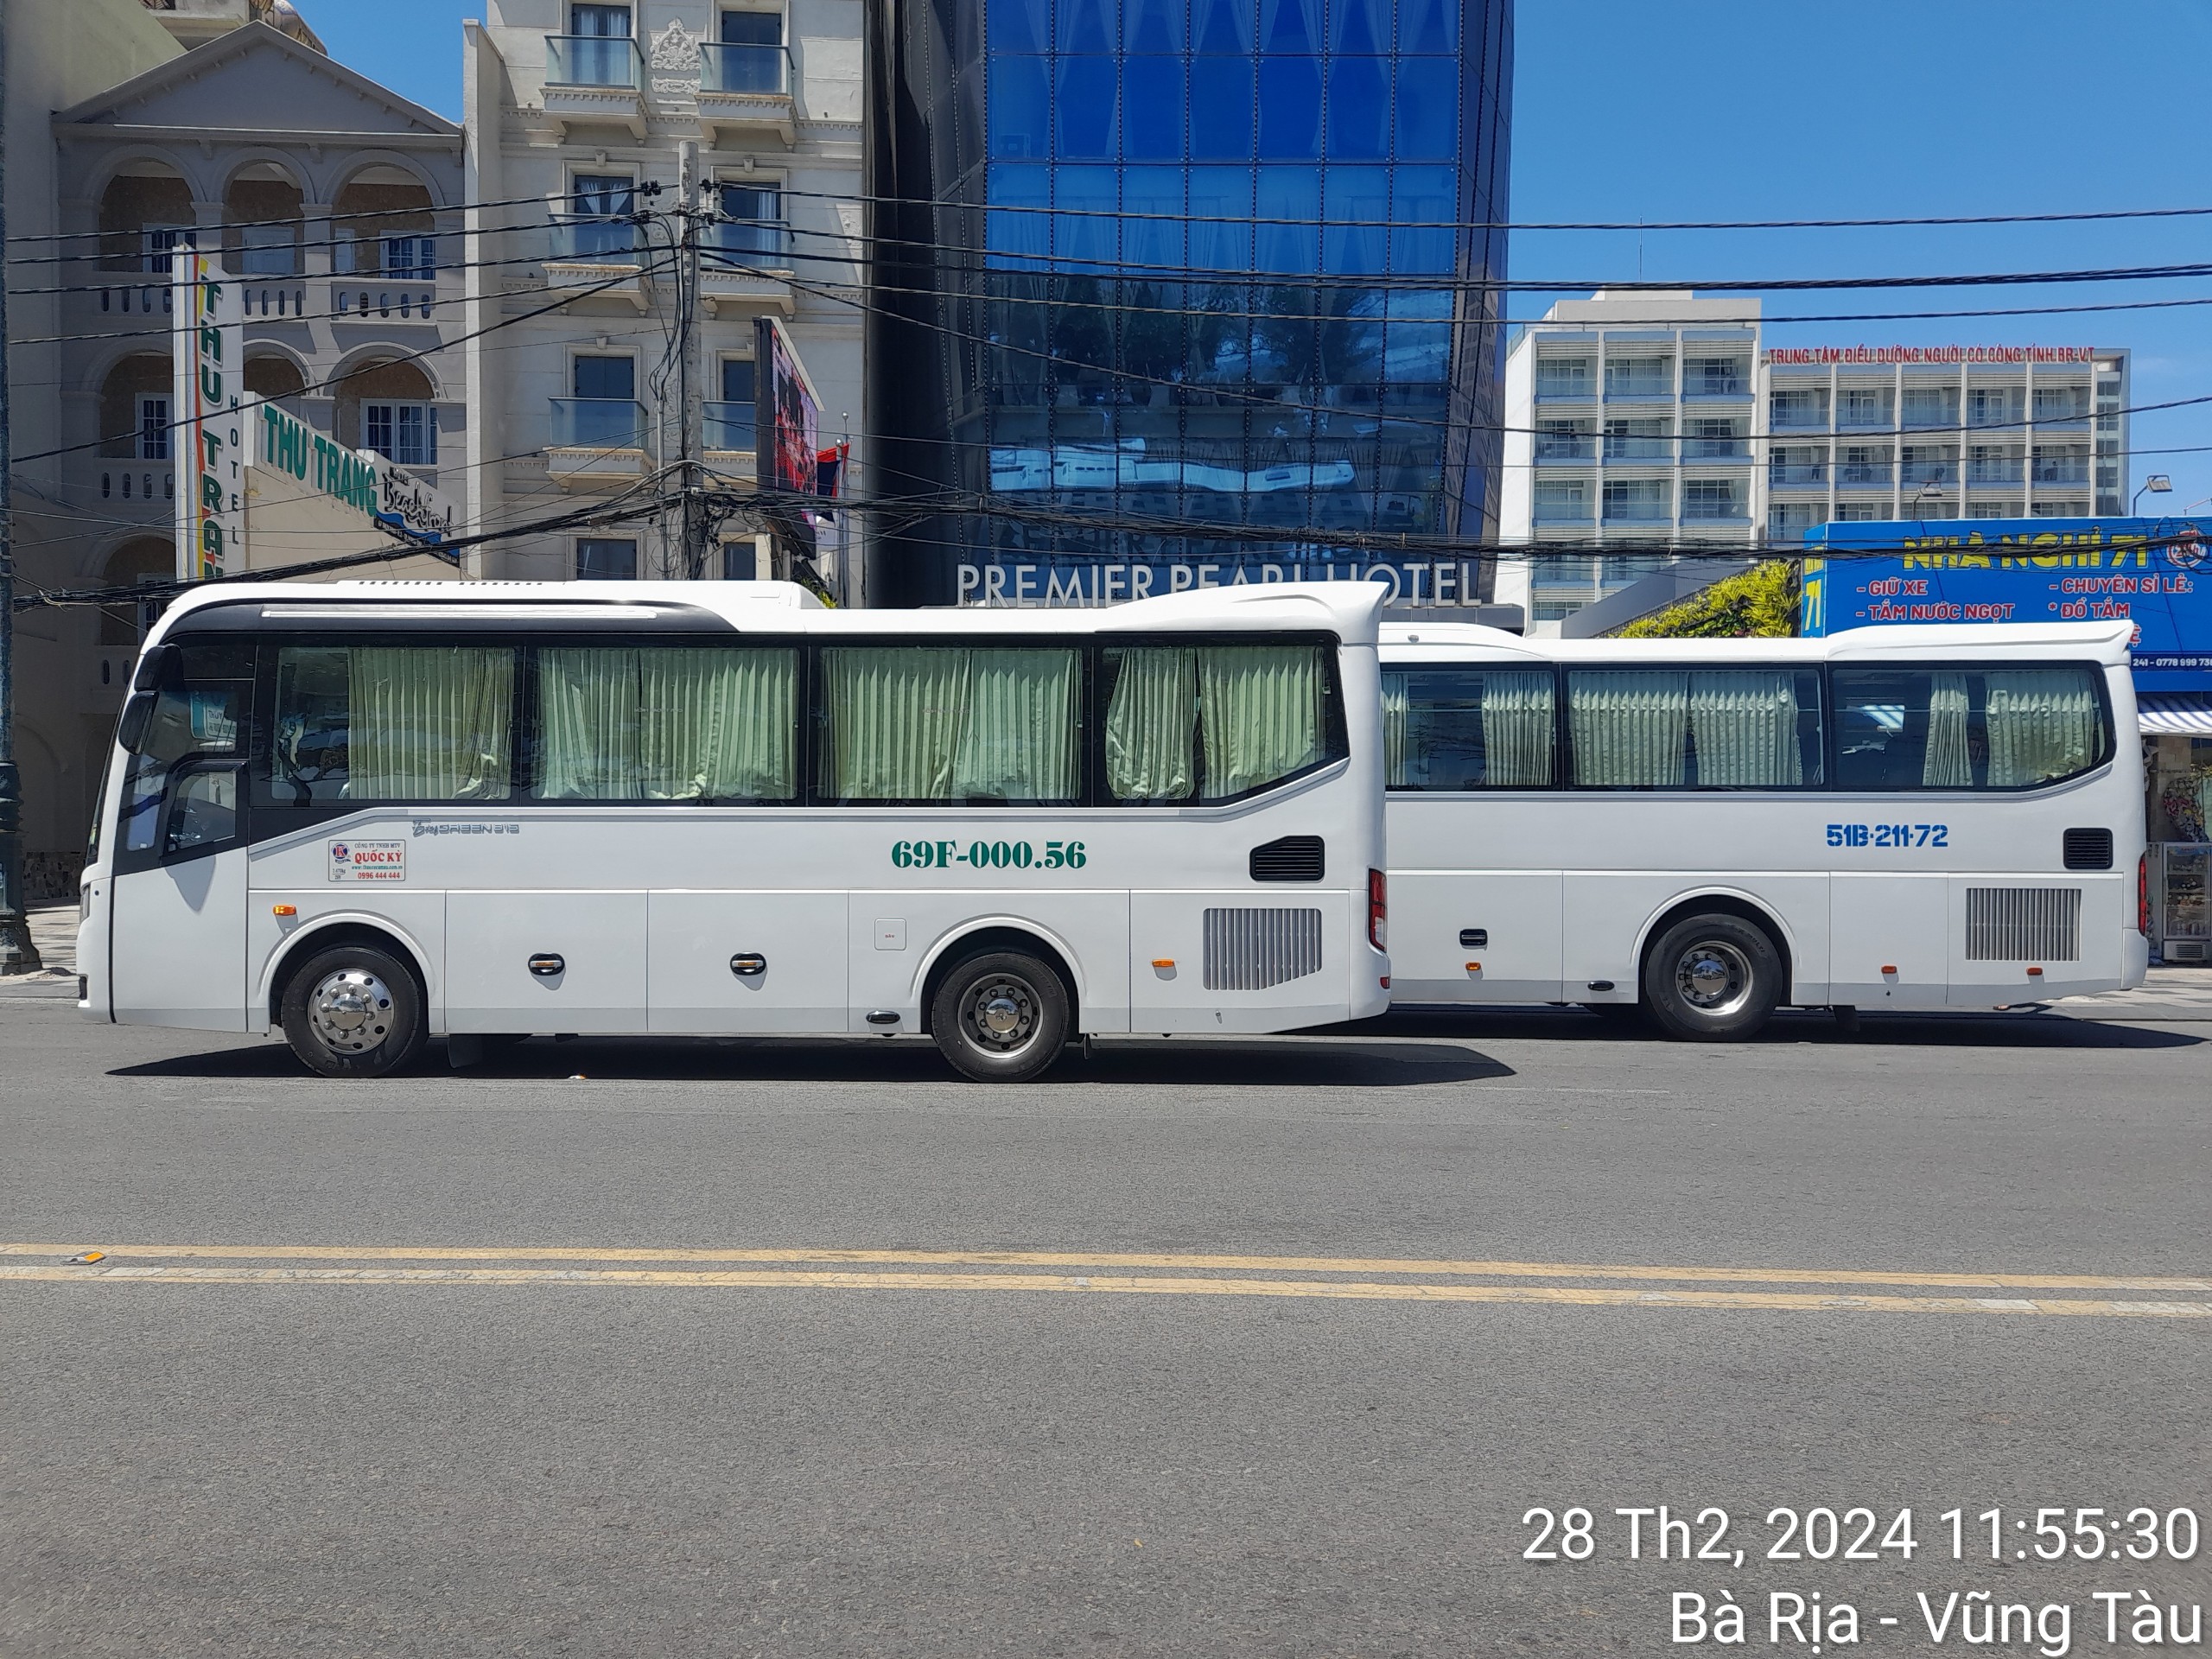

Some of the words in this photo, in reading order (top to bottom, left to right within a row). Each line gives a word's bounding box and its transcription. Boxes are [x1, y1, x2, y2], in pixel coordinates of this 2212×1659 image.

[200, 271, 224, 406] THU
[1770, 348, 1809, 364] TRUNG
[1815, 345, 1840, 364] TÂM
[1877, 344, 1919, 363] DƯỠNG
[1967, 343, 1983, 363] CÓ
[1988, 343, 2021, 363] CÔNG
[2057, 346, 2094, 363] BR-VT
[230, 394, 239, 545] HOTEL
[264, 404, 308, 480] THU
[314, 434, 378, 518] TRANG
[1903, 531, 1991, 569] NHÀ
[2109, 534, 2148, 568] 71
[957, 563, 1154, 608] PREMIER
[1869, 577, 1901, 595] GIỮ
[1903, 580, 1928, 595] XE
[2062, 575, 2138, 594] CHUYÊN
[2141, 573, 2159, 594] SỈ
[1804, 578, 1822, 632] 71
[1869, 600, 1907, 620] TẮM
[1910, 601, 1961, 620] NƯỚC
[1964, 603, 2015, 623] NGỌT
[2090, 596, 2131, 619] TẮM
[2133, 658, 2149, 667] 241
[2156, 658, 2178, 667] 0778
[354, 849, 385, 864] QUỐC
[386, 849, 403, 862] KỲ
[891, 839, 1087, 869] 69F-000.56
